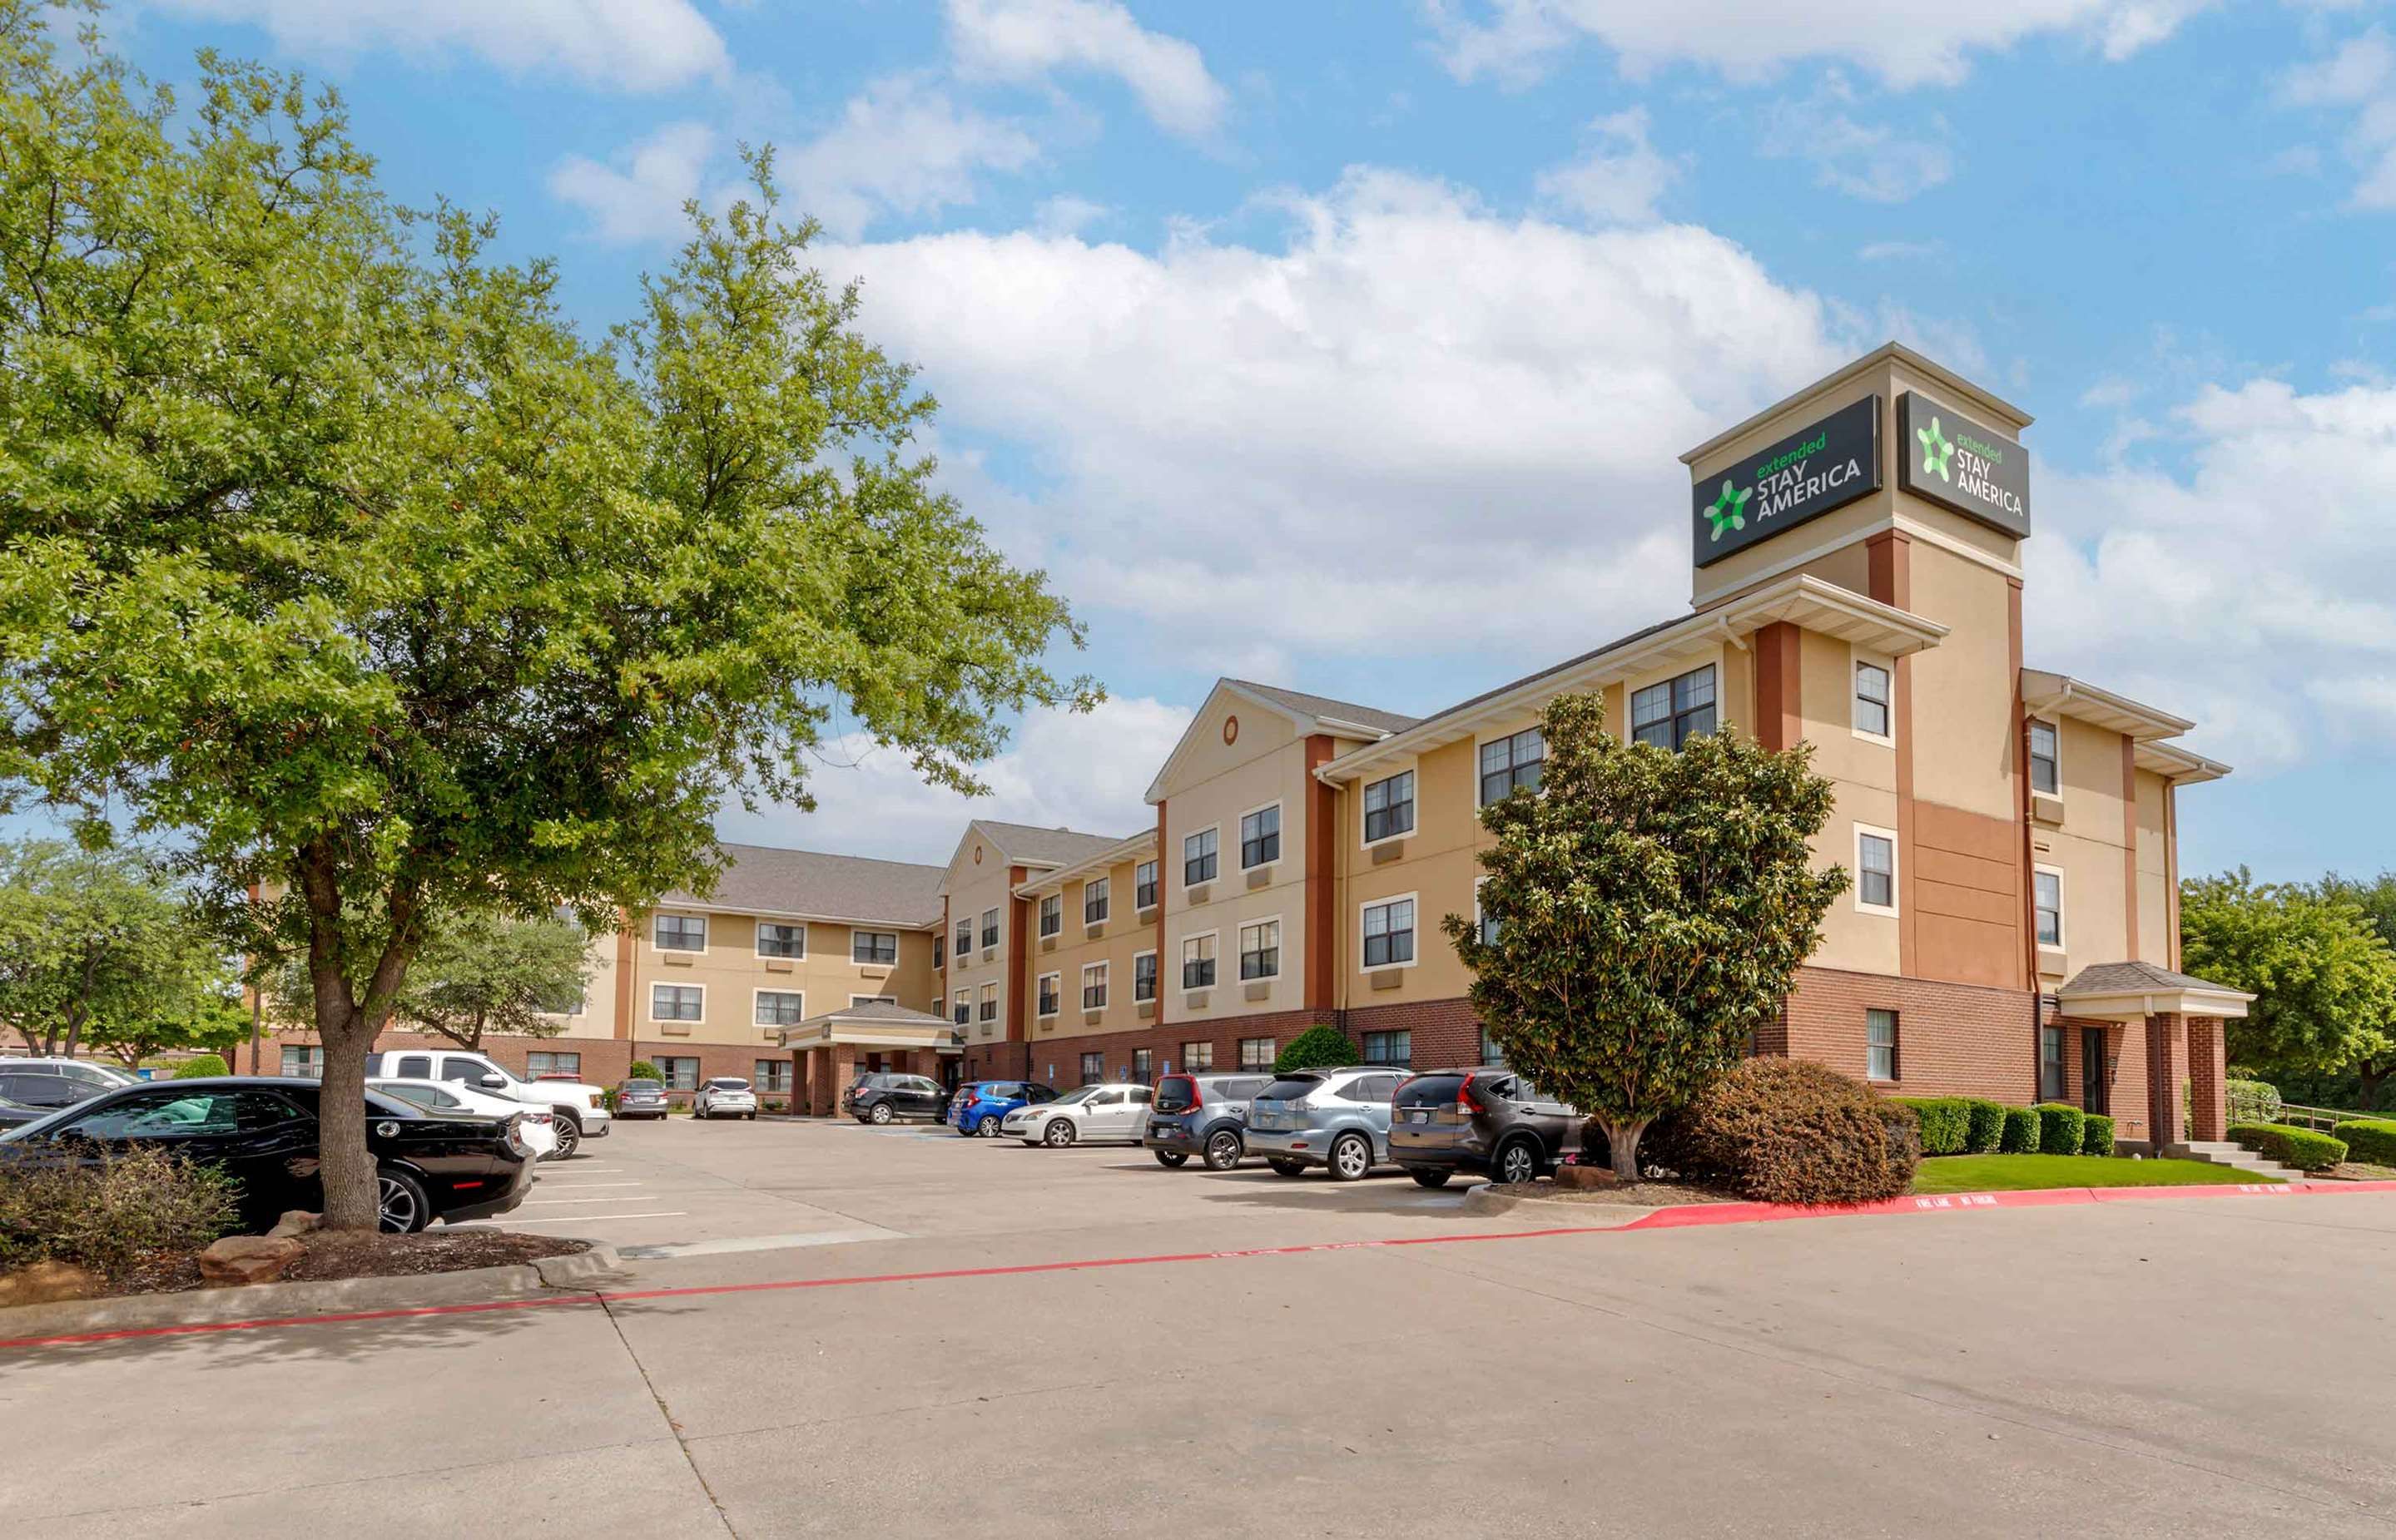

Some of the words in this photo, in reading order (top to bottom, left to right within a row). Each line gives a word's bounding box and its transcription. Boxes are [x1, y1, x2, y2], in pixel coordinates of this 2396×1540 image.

[1757, 431, 1826, 480] extended
[1957, 433, 2002, 465] extended
[1957, 448, 1991, 480] STAY
[1756, 458, 1862, 522] AMERICA
[1757, 459, 1808, 501] STAY
[1957, 470, 2023, 517] AMERICA
